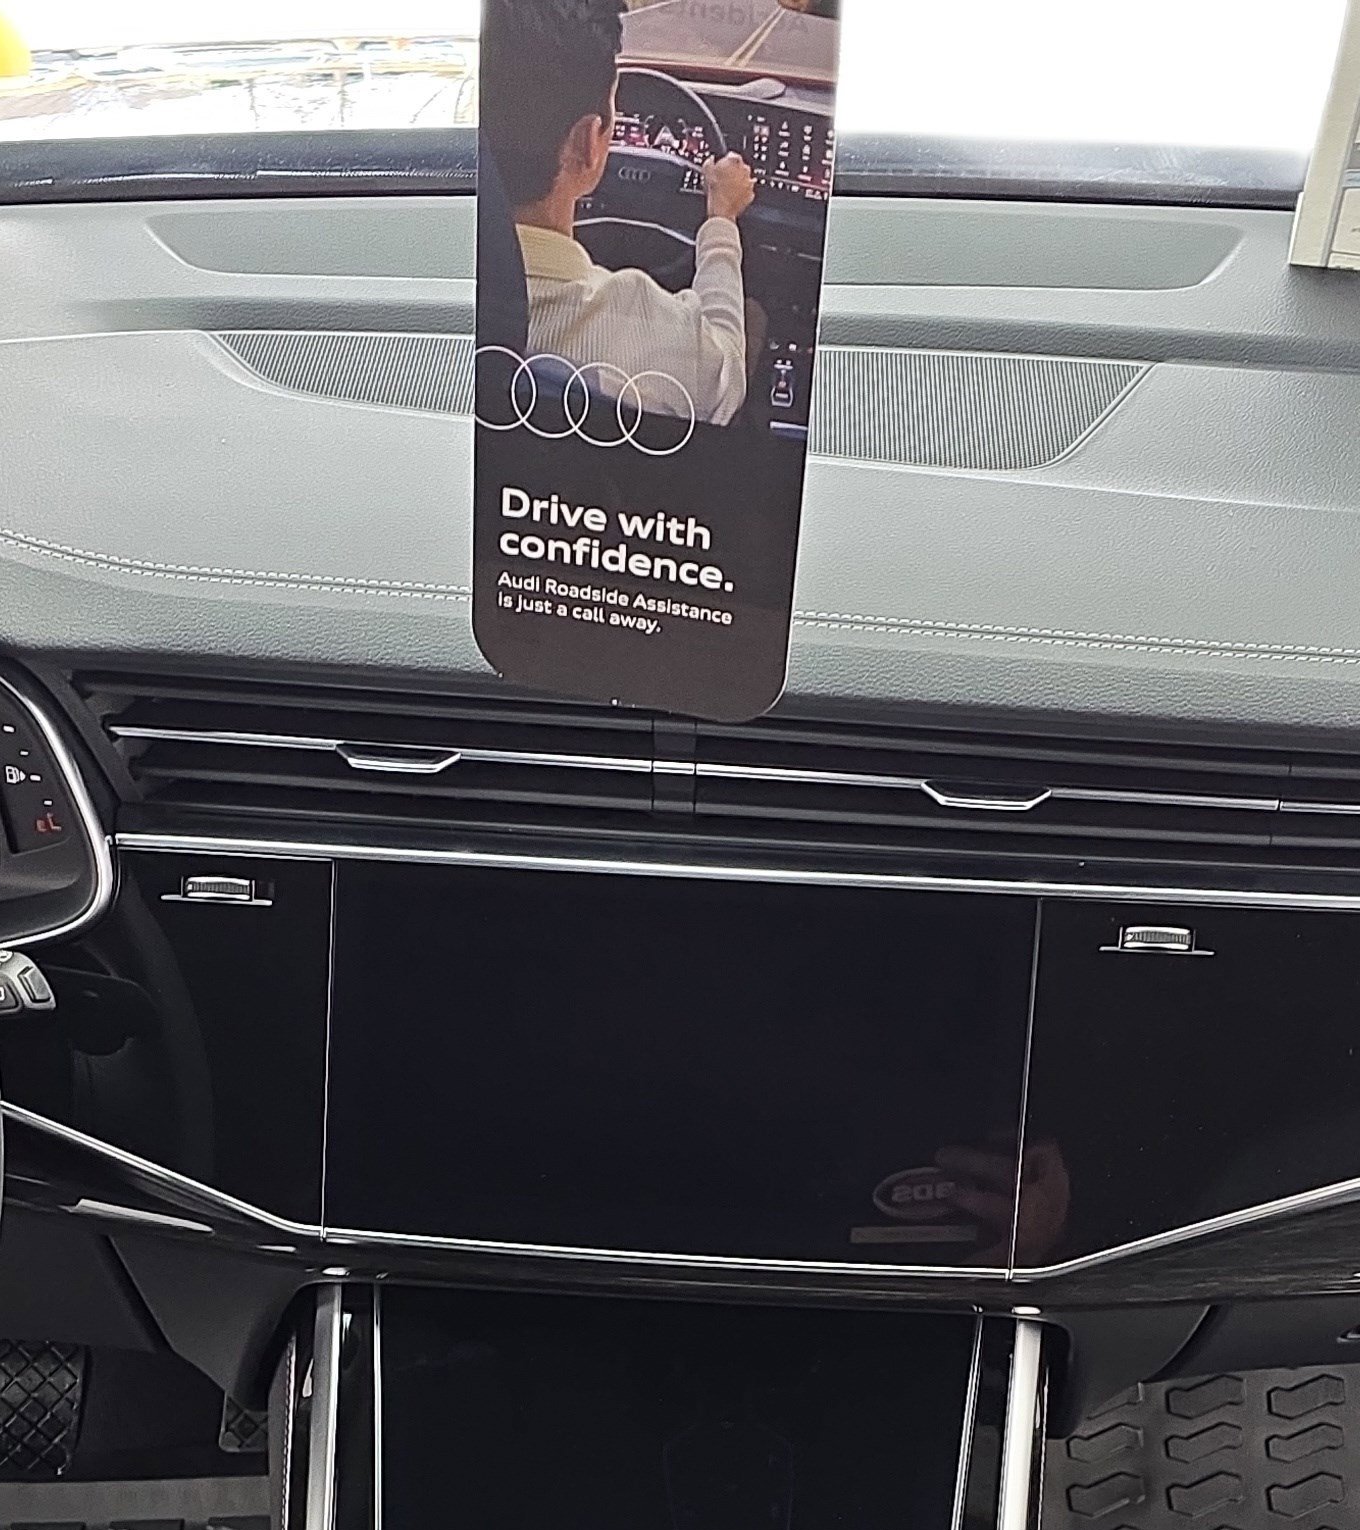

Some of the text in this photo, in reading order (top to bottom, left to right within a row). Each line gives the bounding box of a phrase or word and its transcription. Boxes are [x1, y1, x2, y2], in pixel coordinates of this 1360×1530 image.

[501, 486, 711, 550] Drive with
[499, 532, 734, 592] confidence.
[497, 571, 733, 625] Audi Roadside Assistance
[497, 591, 663, 635] is just a call away.
